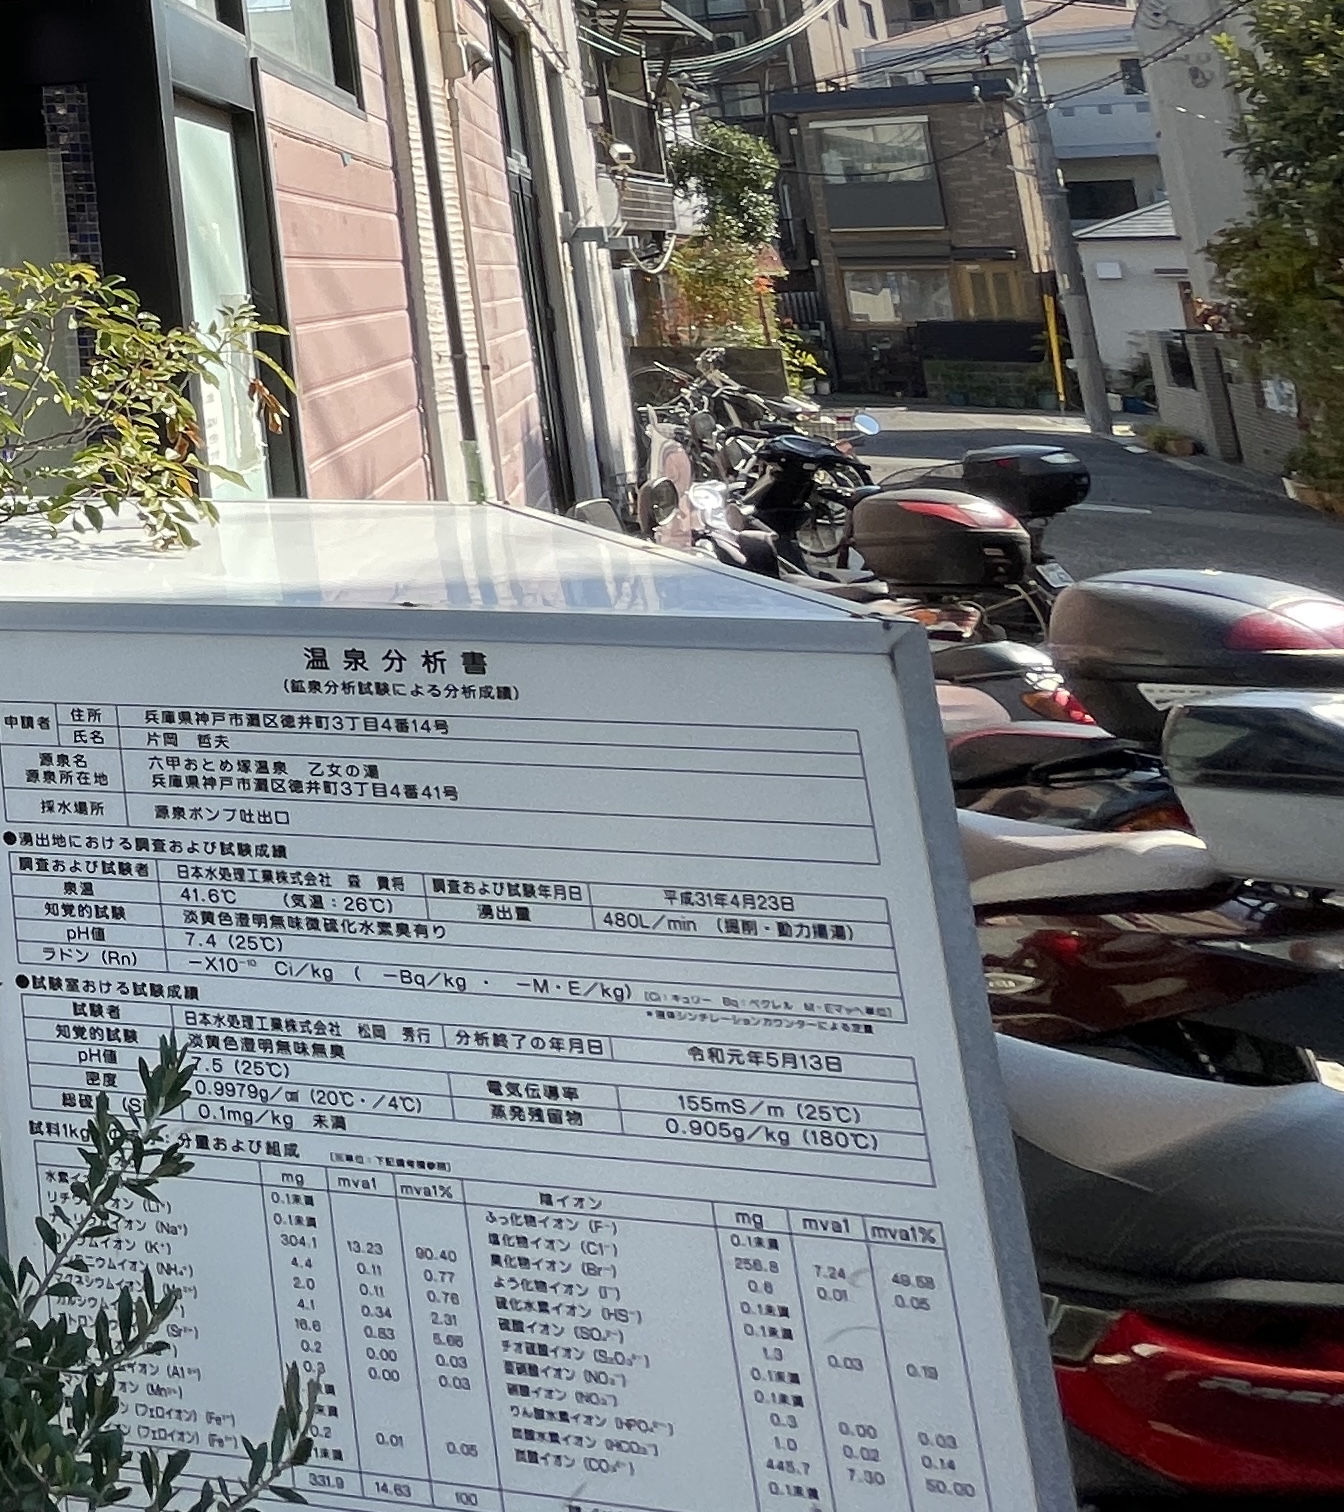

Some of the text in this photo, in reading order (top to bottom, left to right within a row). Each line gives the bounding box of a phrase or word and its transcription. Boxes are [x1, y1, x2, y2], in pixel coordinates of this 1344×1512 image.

[304, 647, 488, 675] 温泉分析書
[3, 715, 50, 730] 申請者
[70, 708, 102, 723] 住所
[73, 729, 105, 745] 氏名
[146, 733, 179, 747] 片岡
[39, 753, 380, 779] 源泉名 六甲おとめ塚温泉 乙女の湯
[25, 769, 109, 787] 源泉所在地
[40, 799, 290, 825] 採水場所 源泉ポンプ吐出口
[19, 856, 149, 878] 調査および試験者
[177, 864, 333, 887] 日本水処理工業株式会社
[664, 889, 795, 912] 平成31年4月23日
[63, 881, 94, 896] 泉温
[180, 888, 236, 904] 41.6℃
[45, 902, 127, 921] 知覚的試験
[67, 926, 105, 942] pH値
[43, 947, 90, 963] ラドン
[102, 949, 137, 967] (Rn)
[55, 1024, 139, 1044] 知覚的試験
[73, 1001, 121, 1020] 試験者
[184, 1011, 342, 1036] 日本水処理工業株式会社
[456, 1030, 604, 1056] 分析終了の年月日
[688, 1046, 842, 1073] 令和元年5月13日
[78, 1049, 118, 1064] pH値
[85, 1071, 118, 1087] 密度
[487, 1080, 580, 1101] 電気伝導率
[198, 1104, 294, 1130] 0.1mg/kg
[313, 1114, 347, 1130] 未満
[282, 1172, 304, 1186] mg
[736, 1211, 763, 1231] mg
